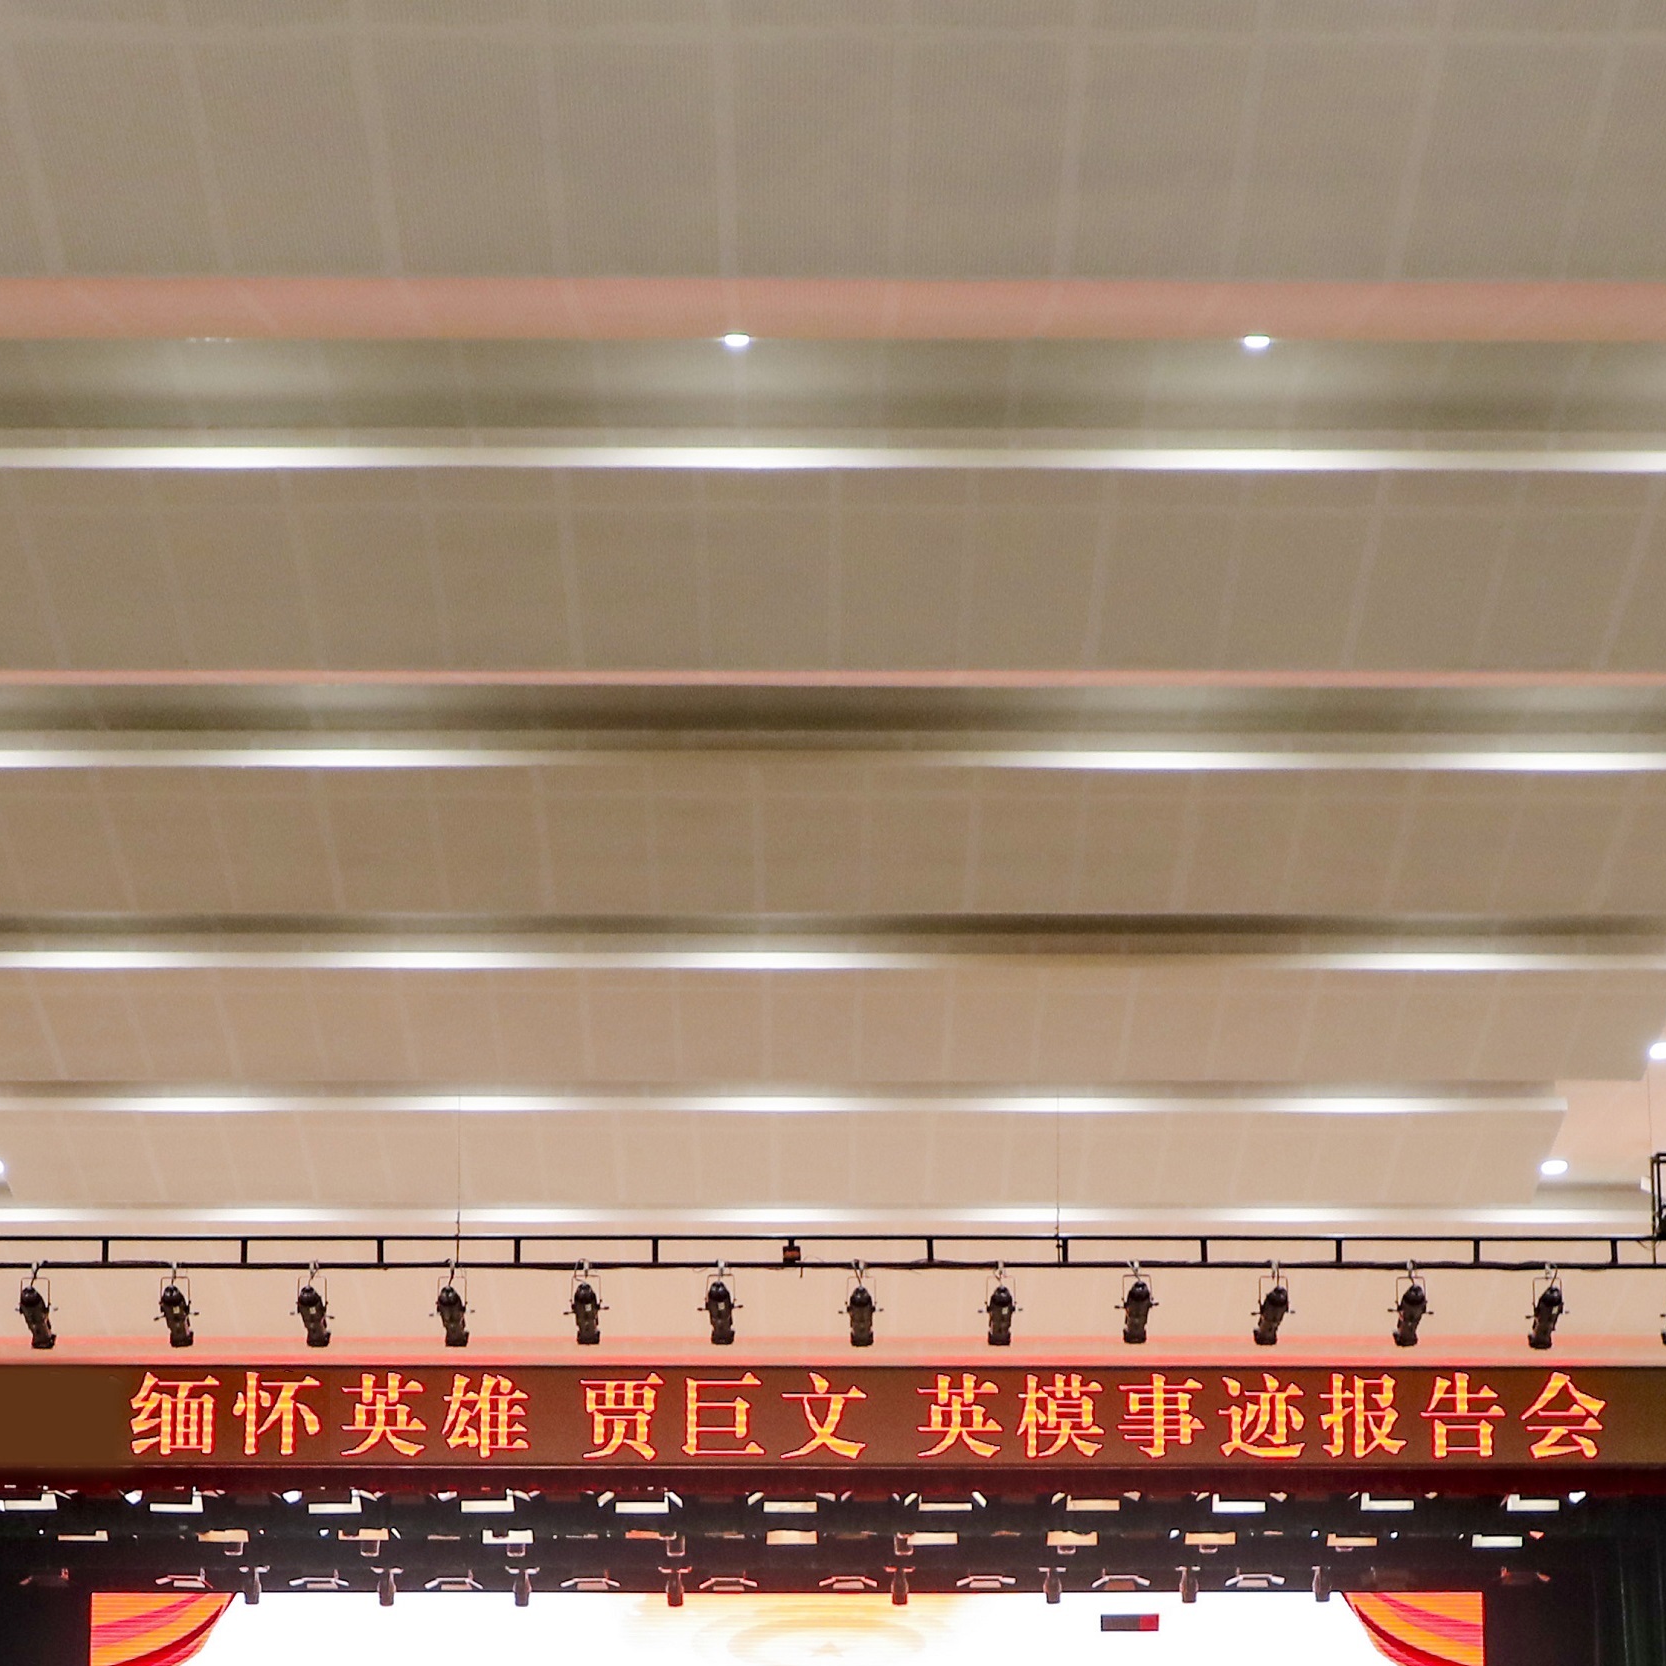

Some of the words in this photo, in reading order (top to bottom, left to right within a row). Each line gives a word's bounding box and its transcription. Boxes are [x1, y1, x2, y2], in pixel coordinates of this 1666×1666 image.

[131, 1370, 534, 1459] 缅怀英雄
[581, 1371, 870, 1461] 贾巨文
[917, 1370, 1608, 1461] 英模事迹报告会
